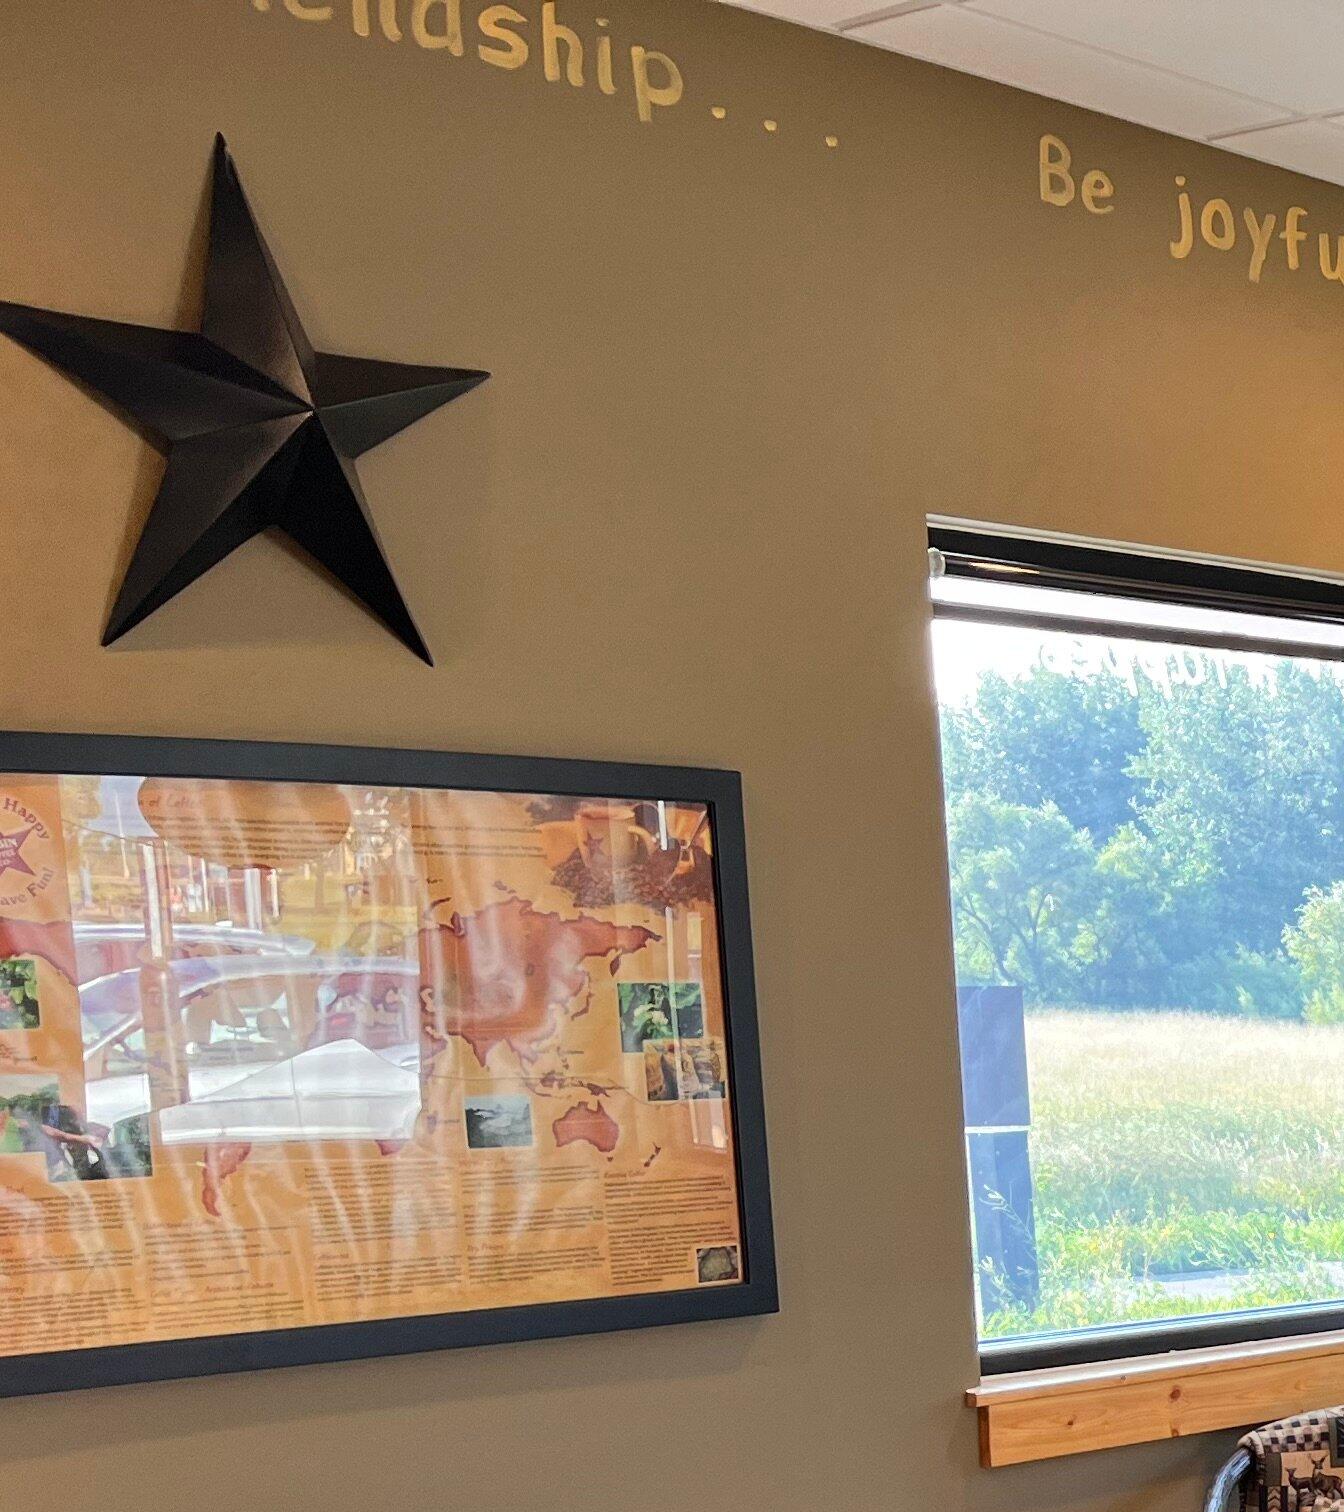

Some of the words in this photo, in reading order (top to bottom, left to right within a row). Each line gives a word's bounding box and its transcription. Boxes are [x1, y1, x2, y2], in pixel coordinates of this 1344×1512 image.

[1040, 135, 1114, 214] Be
[4, 798, 50, 840] Happy
[0, 893, 28, 906] ave
